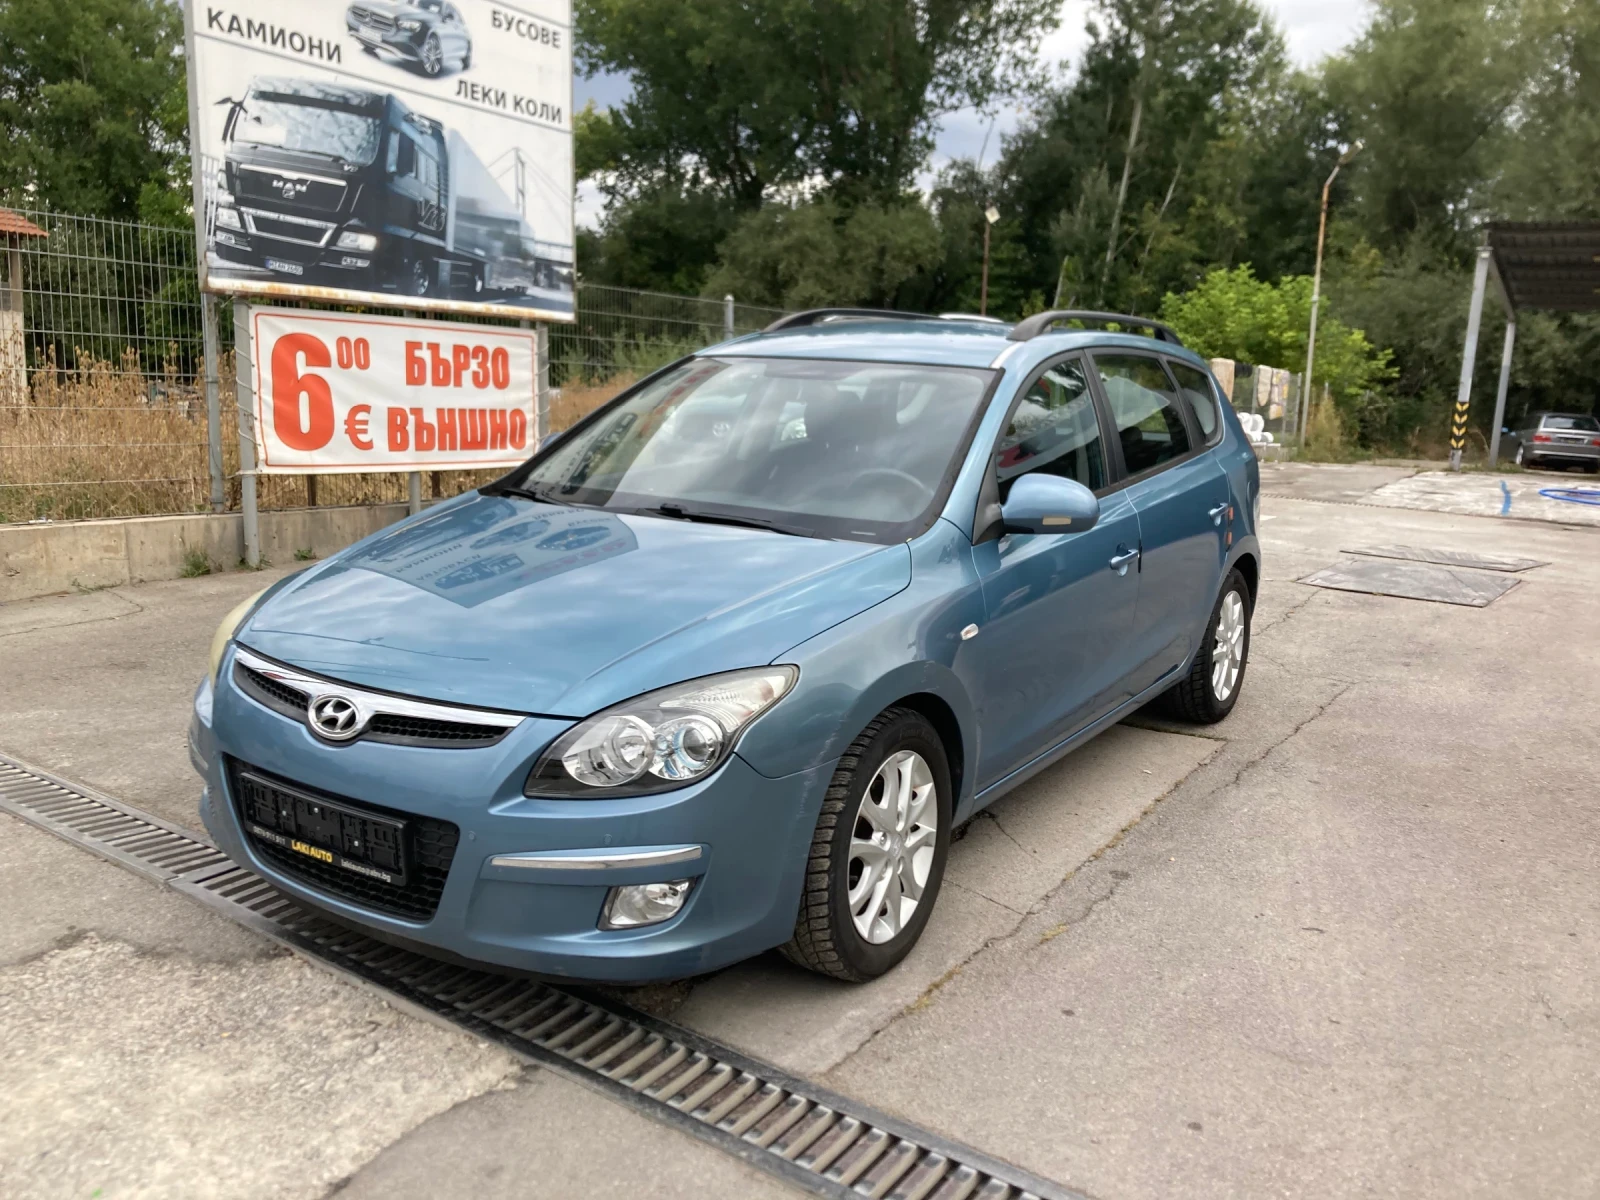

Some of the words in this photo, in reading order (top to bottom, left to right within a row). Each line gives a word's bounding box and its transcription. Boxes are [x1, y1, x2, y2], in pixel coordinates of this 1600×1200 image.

[207, 7, 341, 63] КАМИОНИ
[491, 9, 561, 49] БУСОВЕ
[456, 79, 507, 109] ЛЕКИ
[513, 95, 562, 124] КОЛИ
[405, 340, 510, 390] БЪРЗО
[271, 332, 335, 451] 6
[336, 336, 371, 370] 00
[344, 404, 374, 450] €
[387, 407, 527, 452] ВЪНШНО
[291, 839, 310, 855] LAKI
[310, 847, 332, 863] AUTO
